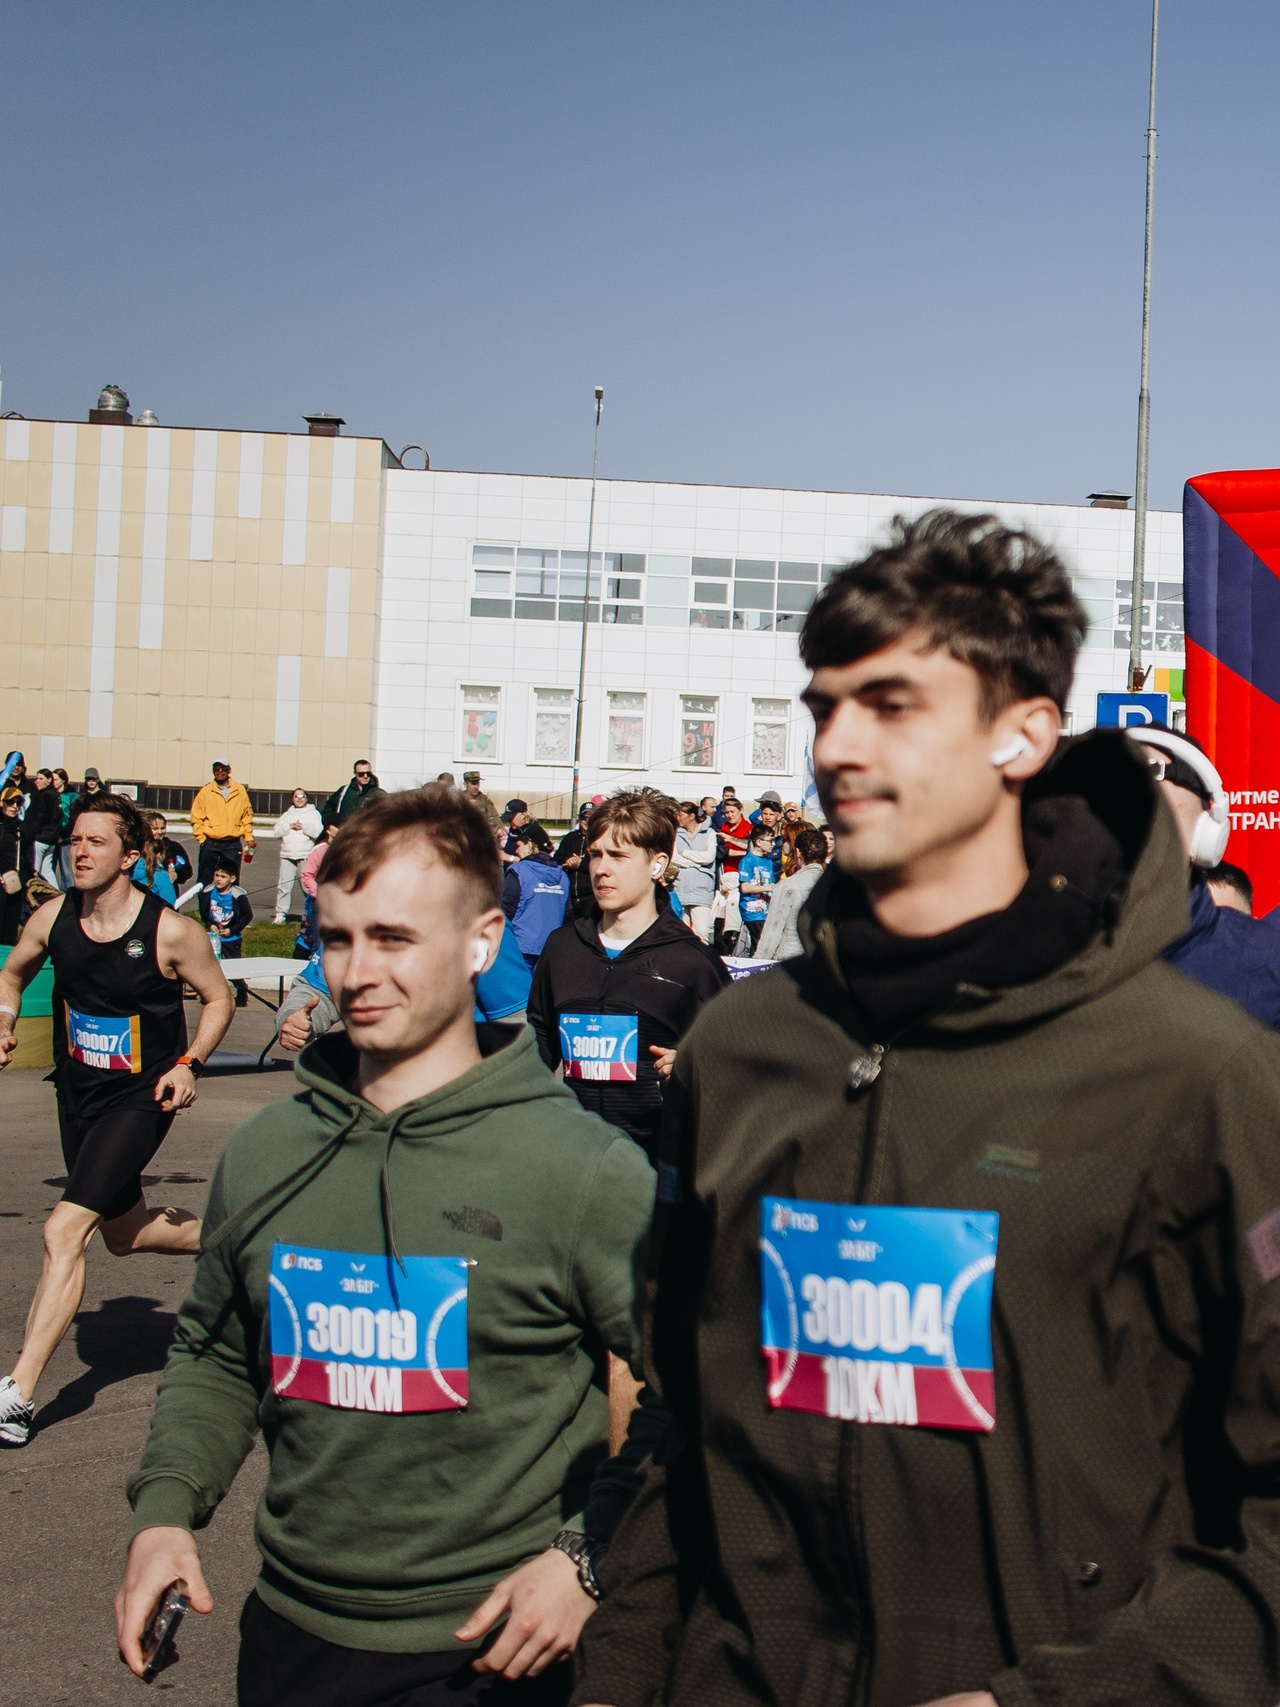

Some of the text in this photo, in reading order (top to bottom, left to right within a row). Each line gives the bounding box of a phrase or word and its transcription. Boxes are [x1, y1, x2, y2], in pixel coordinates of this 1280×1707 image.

[682, 722, 713, 766] 9 МАЯ
[76, 1028, 119, 1053] 30007
[572, 1036, 618, 1059] 30017
[790, 1211, 819, 1233] ПСБ
[297, 1257, 323, 1271] ПСБ
[801, 1273, 948, 1356] 30004
[306, 1302, 418, 1361] 30019
